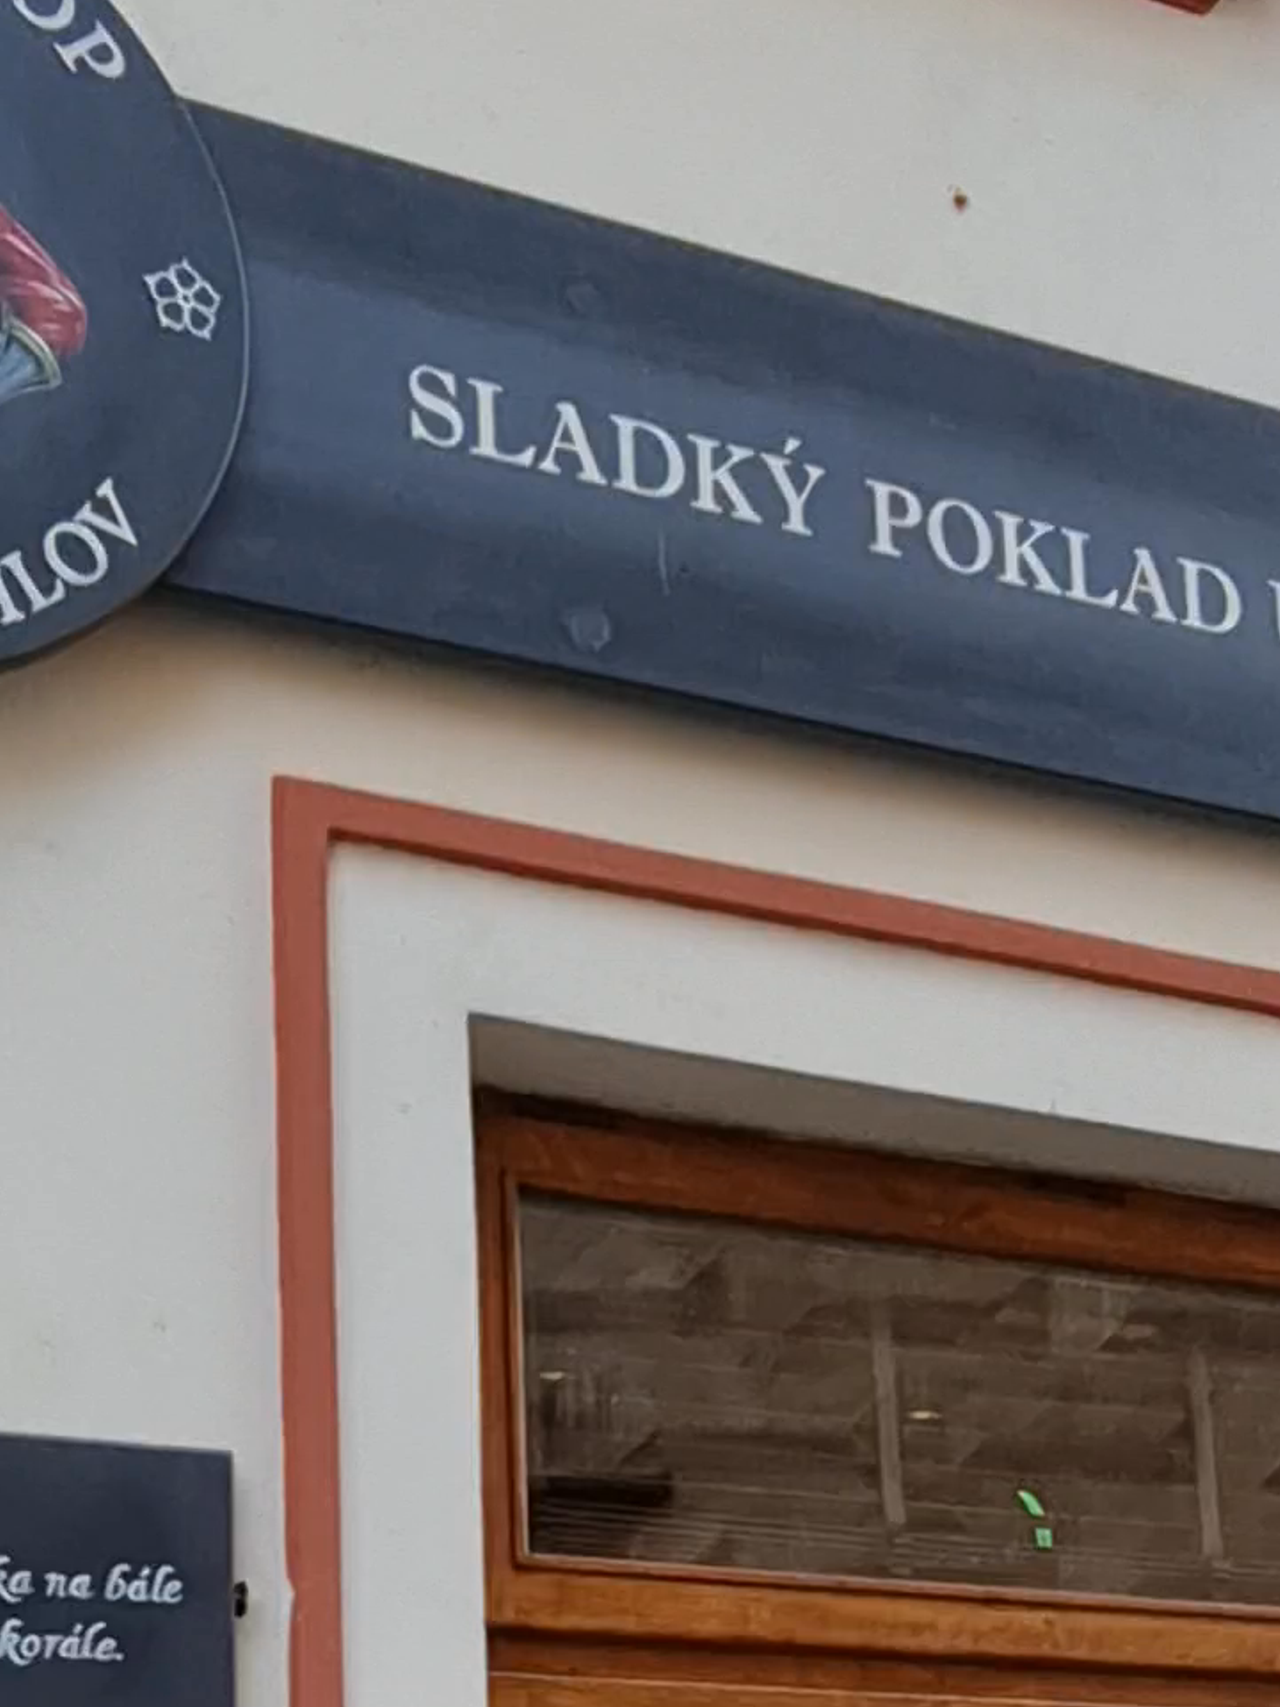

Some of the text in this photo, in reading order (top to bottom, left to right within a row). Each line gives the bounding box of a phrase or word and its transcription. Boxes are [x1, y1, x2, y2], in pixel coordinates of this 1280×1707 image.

[408, 363, 826, 537] SLADKÝ
[864, 477, 1243, 634] POKLAD
[43, 1571, 93, 1600] na
[104, 1562, 184, 1605] bále
